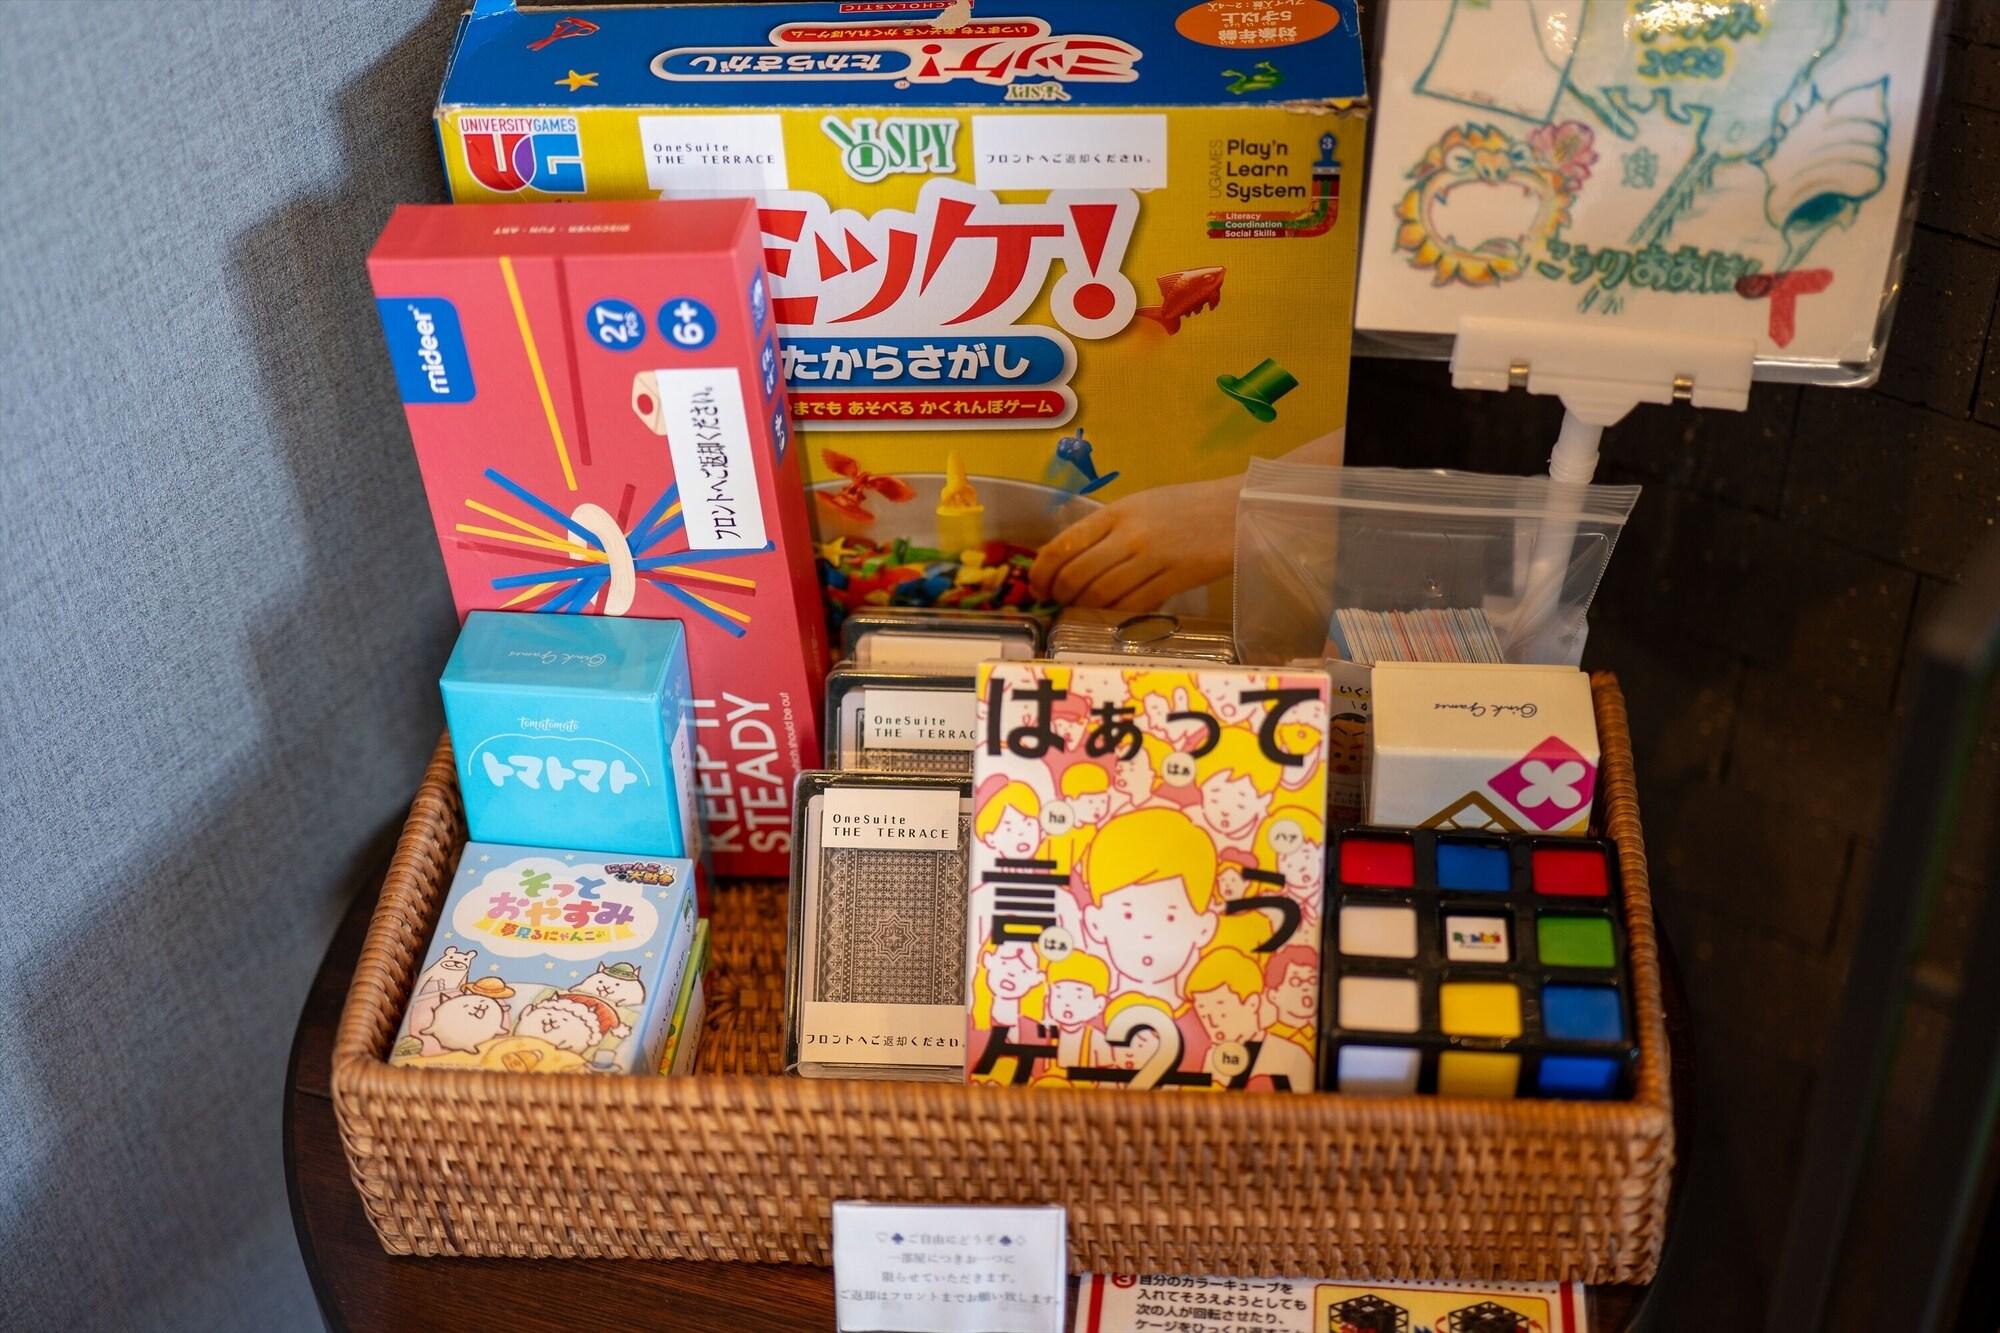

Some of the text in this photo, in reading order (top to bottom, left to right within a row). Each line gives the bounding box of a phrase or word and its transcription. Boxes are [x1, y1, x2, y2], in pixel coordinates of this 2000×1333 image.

[689, 53, 881, 73] たからさがし
[653, 143, 730, 153] OneSuite
[885, 122, 953, 169] SPY
[1322, 135, 1333, 150] 3
[656, 154, 776, 165] THE TERRACE
[1226, 161, 1288, 177] Learn
[1226, 182, 1306, 202] System
[1225, 212, 1261, 221] Literacy
[1225, 220, 1283, 229] Coordination
[1224, 229, 1277, 238] Social Skills
[596, 306, 629, 343] 27
[672, 301, 705, 345] 6+
[412, 306, 450, 394] mideer
[848, 401, 914, 415] あそべる
[920, 400, 1053, 414] かくれんぼゲーム
[873, 715, 947, 726] OneSuite
[986, 678, 1320, 767] はぁって
[873, 727, 976, 740] THE TERRAC
[482, 751, 638, 794] トマトマト
[722, 691, 791, 854] STEADY
[832, 813, 906, 825] OneSuite
[1048, 809, 1067, 825] ha
[832, 826, 950, 839] THE TERRACE
[518, 868, 607, 899] そっと
[487, 891, 635, 929] おやすみ
[1222, 1051, 1241, 1066] ha
[1136, 1288, 1308, 1311] 入れてそろえようとしても
